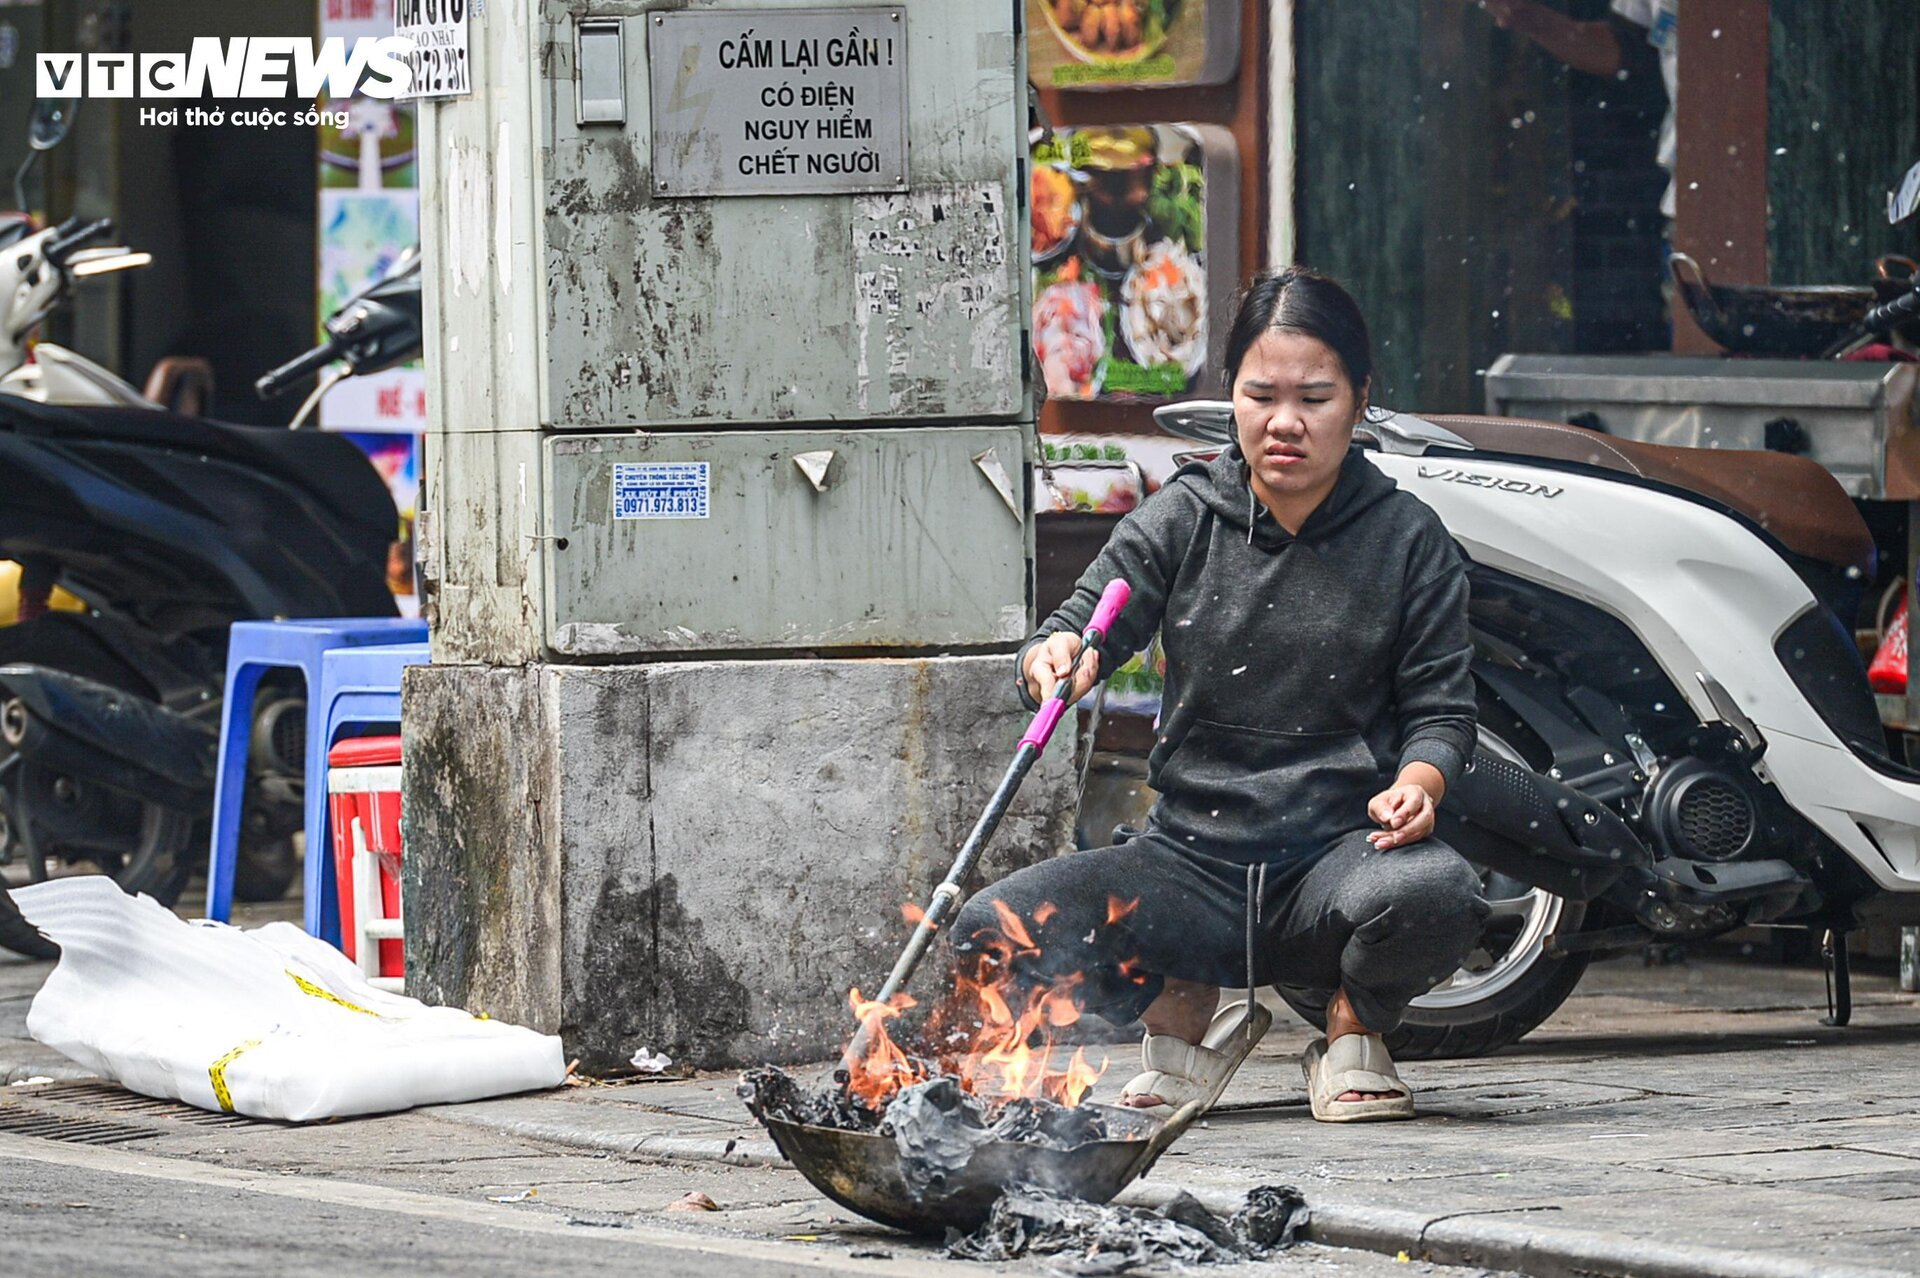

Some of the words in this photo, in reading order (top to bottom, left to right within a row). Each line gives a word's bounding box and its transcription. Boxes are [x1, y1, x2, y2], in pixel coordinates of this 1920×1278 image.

[719, 29, 773, 69] CẤM
[781, 39, 819, 75] LẠI
[826, 26, 879, 67] GẦN
[761, 81, 794, 107] CÓ
[800, 81, 854, 111] ĐIỆN
[745, 119, 809, 140] NGUY
[817, 109, 872, 139] HIỂM
[739, 146, 800, 175] CHẾT
[807, 146, 880, 174] NGƯỜI
[1418, 465, 1564, 498] VISION
[624, 498, 697, 512] 0971.973.813
